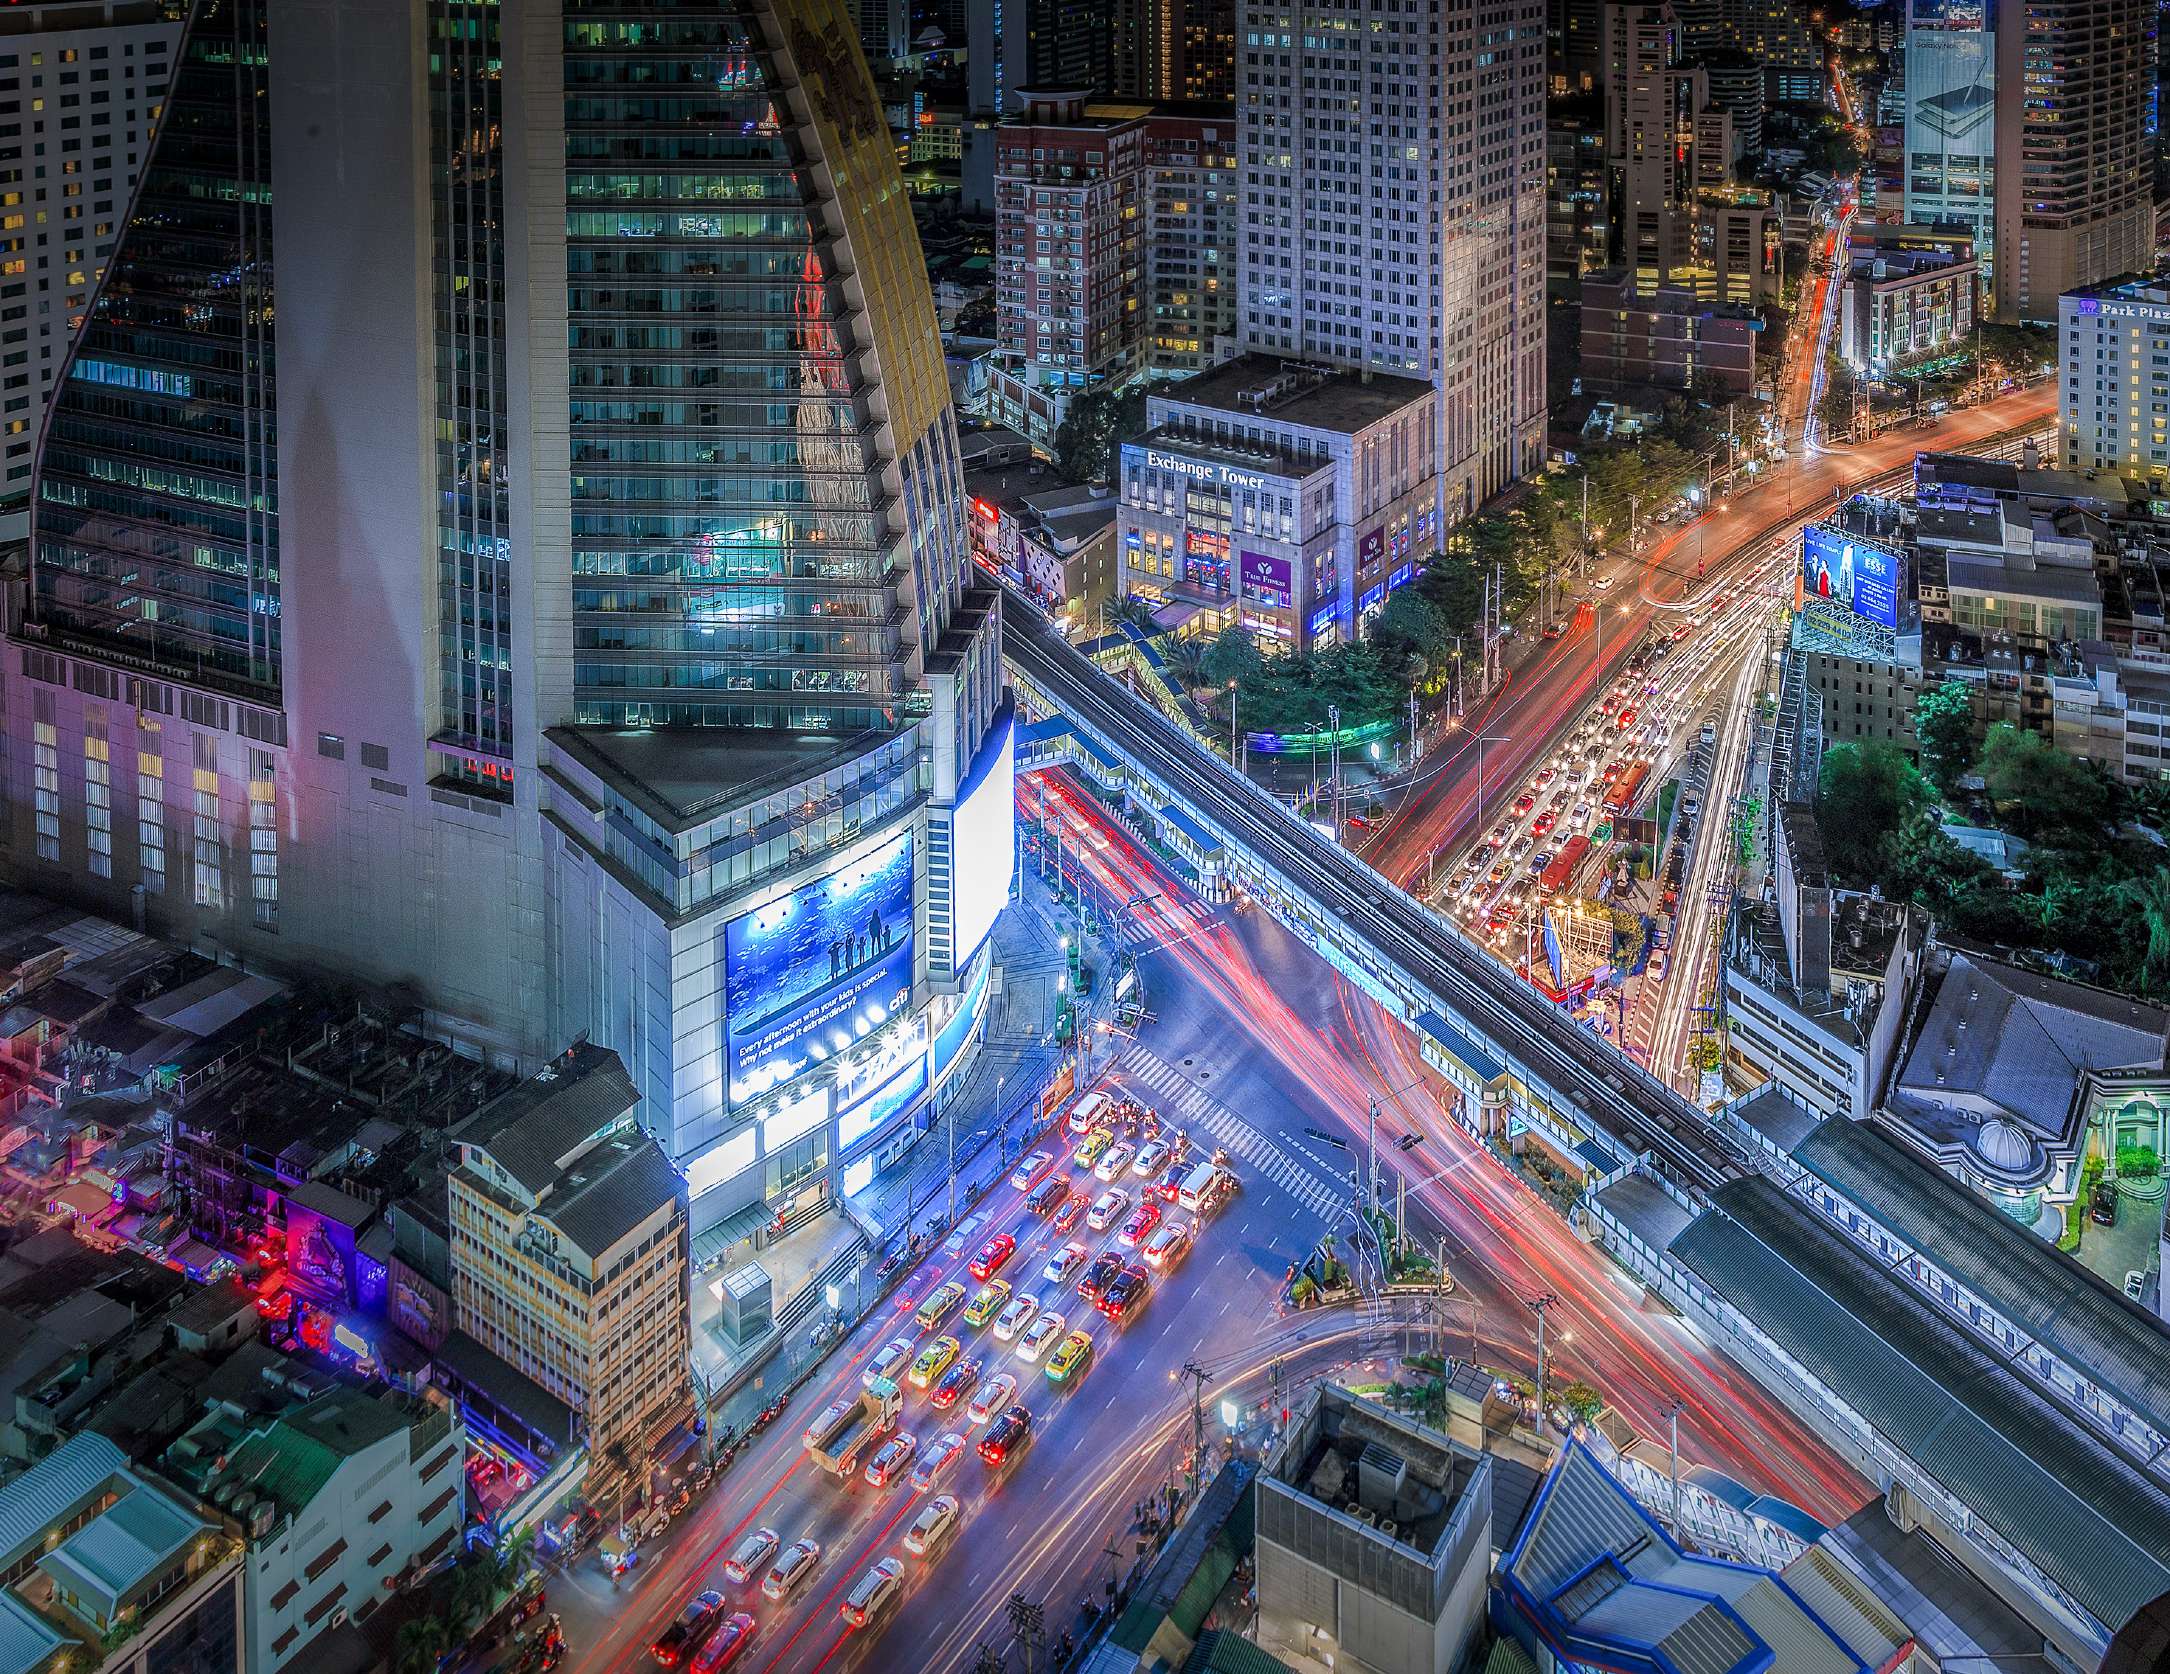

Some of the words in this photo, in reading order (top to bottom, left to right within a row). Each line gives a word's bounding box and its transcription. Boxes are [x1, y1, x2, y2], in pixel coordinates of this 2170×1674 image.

[2101, 304, 2135, 317] Park
[1147, 451, 1213, 480] Exchange
[1219, 466, 1265, 489] Tower
[1864, 557, 1887, 575] ESSE
[740, 1040, 762, 1057] Every
[763, 1016, 802, 1044] afternoon
[803, 1006, 820, 1021] with
[820, 997, 838, 1014] your
[839, 987, 854, 1002] kids
[854, 984, 861, 993] is
[862, 968, 888, 989] special.
[740, 1053, 758, 1068] Why
[758, 1043, 773, 1057] not
[773, 1033, 795, 1049] make
[795, 1028, 802, 1037] it
[803, 996, 857, 1033] extraordinary?
